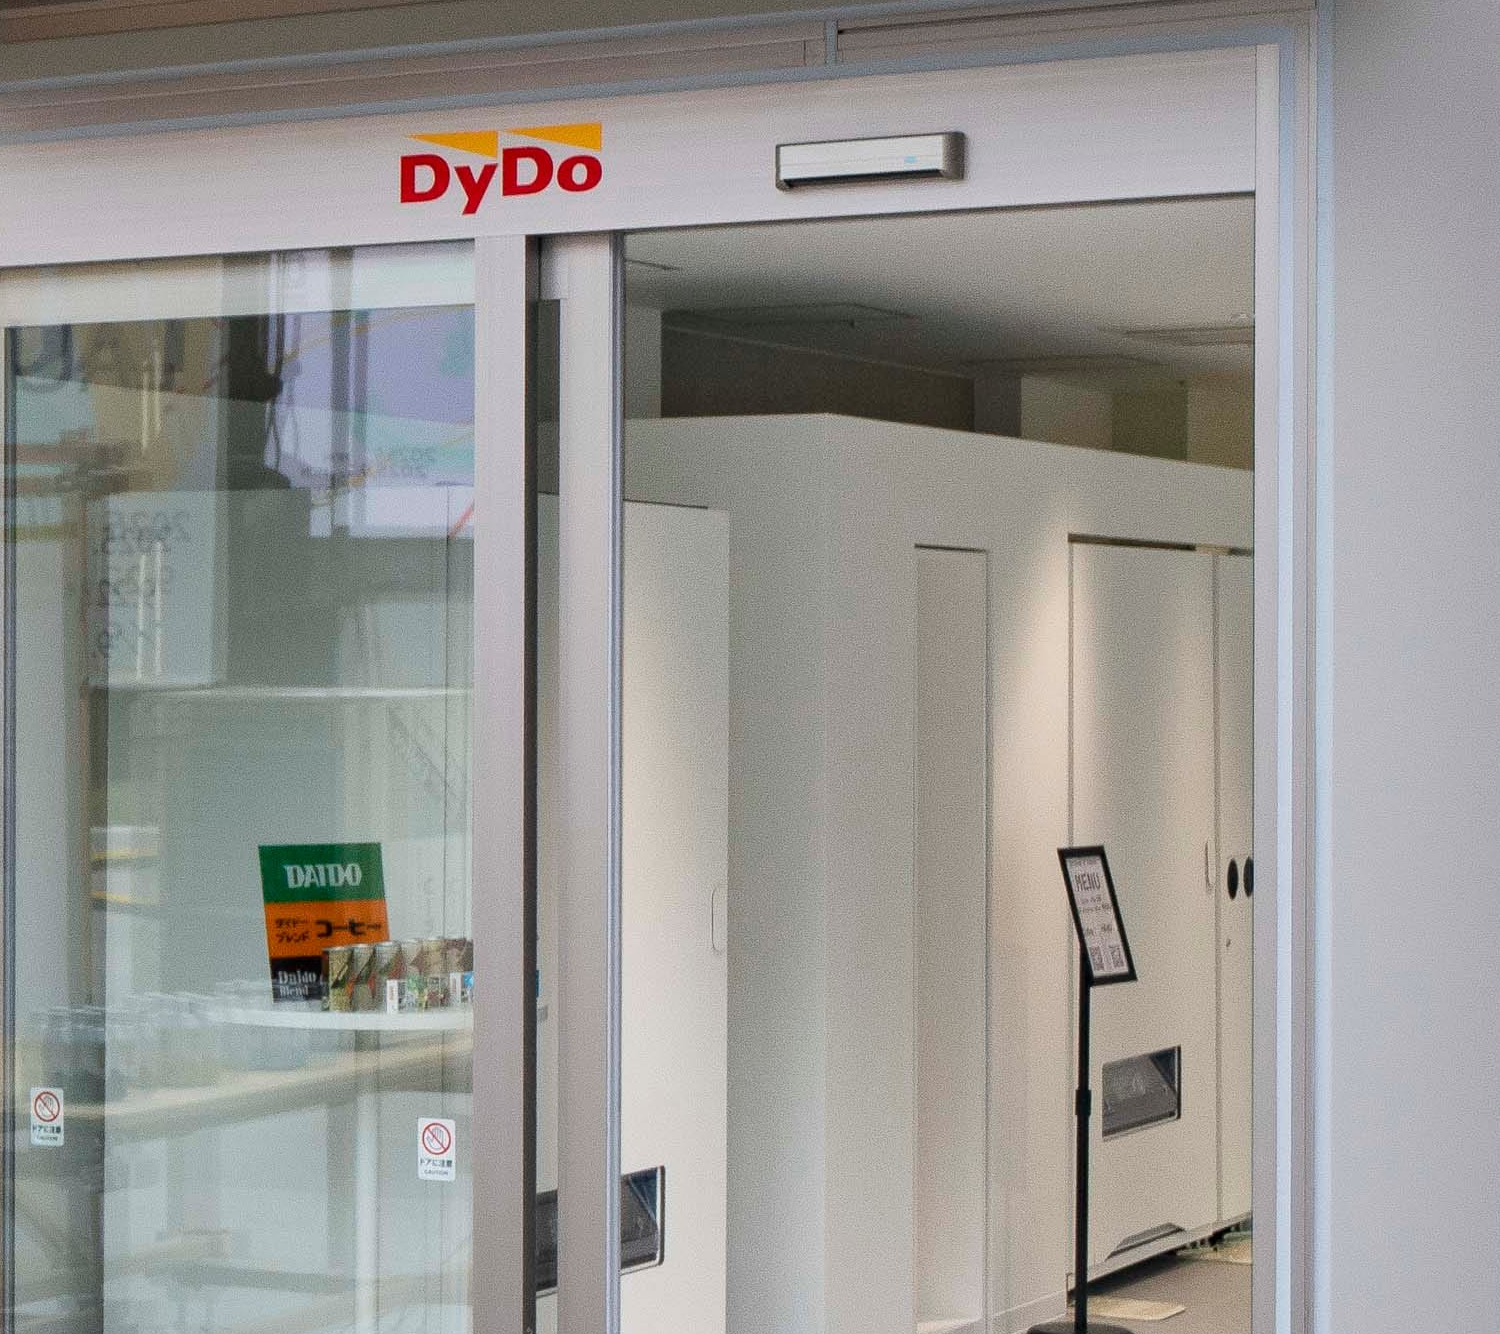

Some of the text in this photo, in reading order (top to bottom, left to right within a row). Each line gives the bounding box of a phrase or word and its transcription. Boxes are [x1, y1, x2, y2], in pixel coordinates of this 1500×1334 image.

[400, 146, 603, 216] DyDo
[283, 862, 363, 889] DAIDO
[1074, 874, 1101, 892] MENU
[316, 918, 382, 938] コーヒー
[278, 970, 318, 985] Daido
[279, 985, 310, 997] Blend
